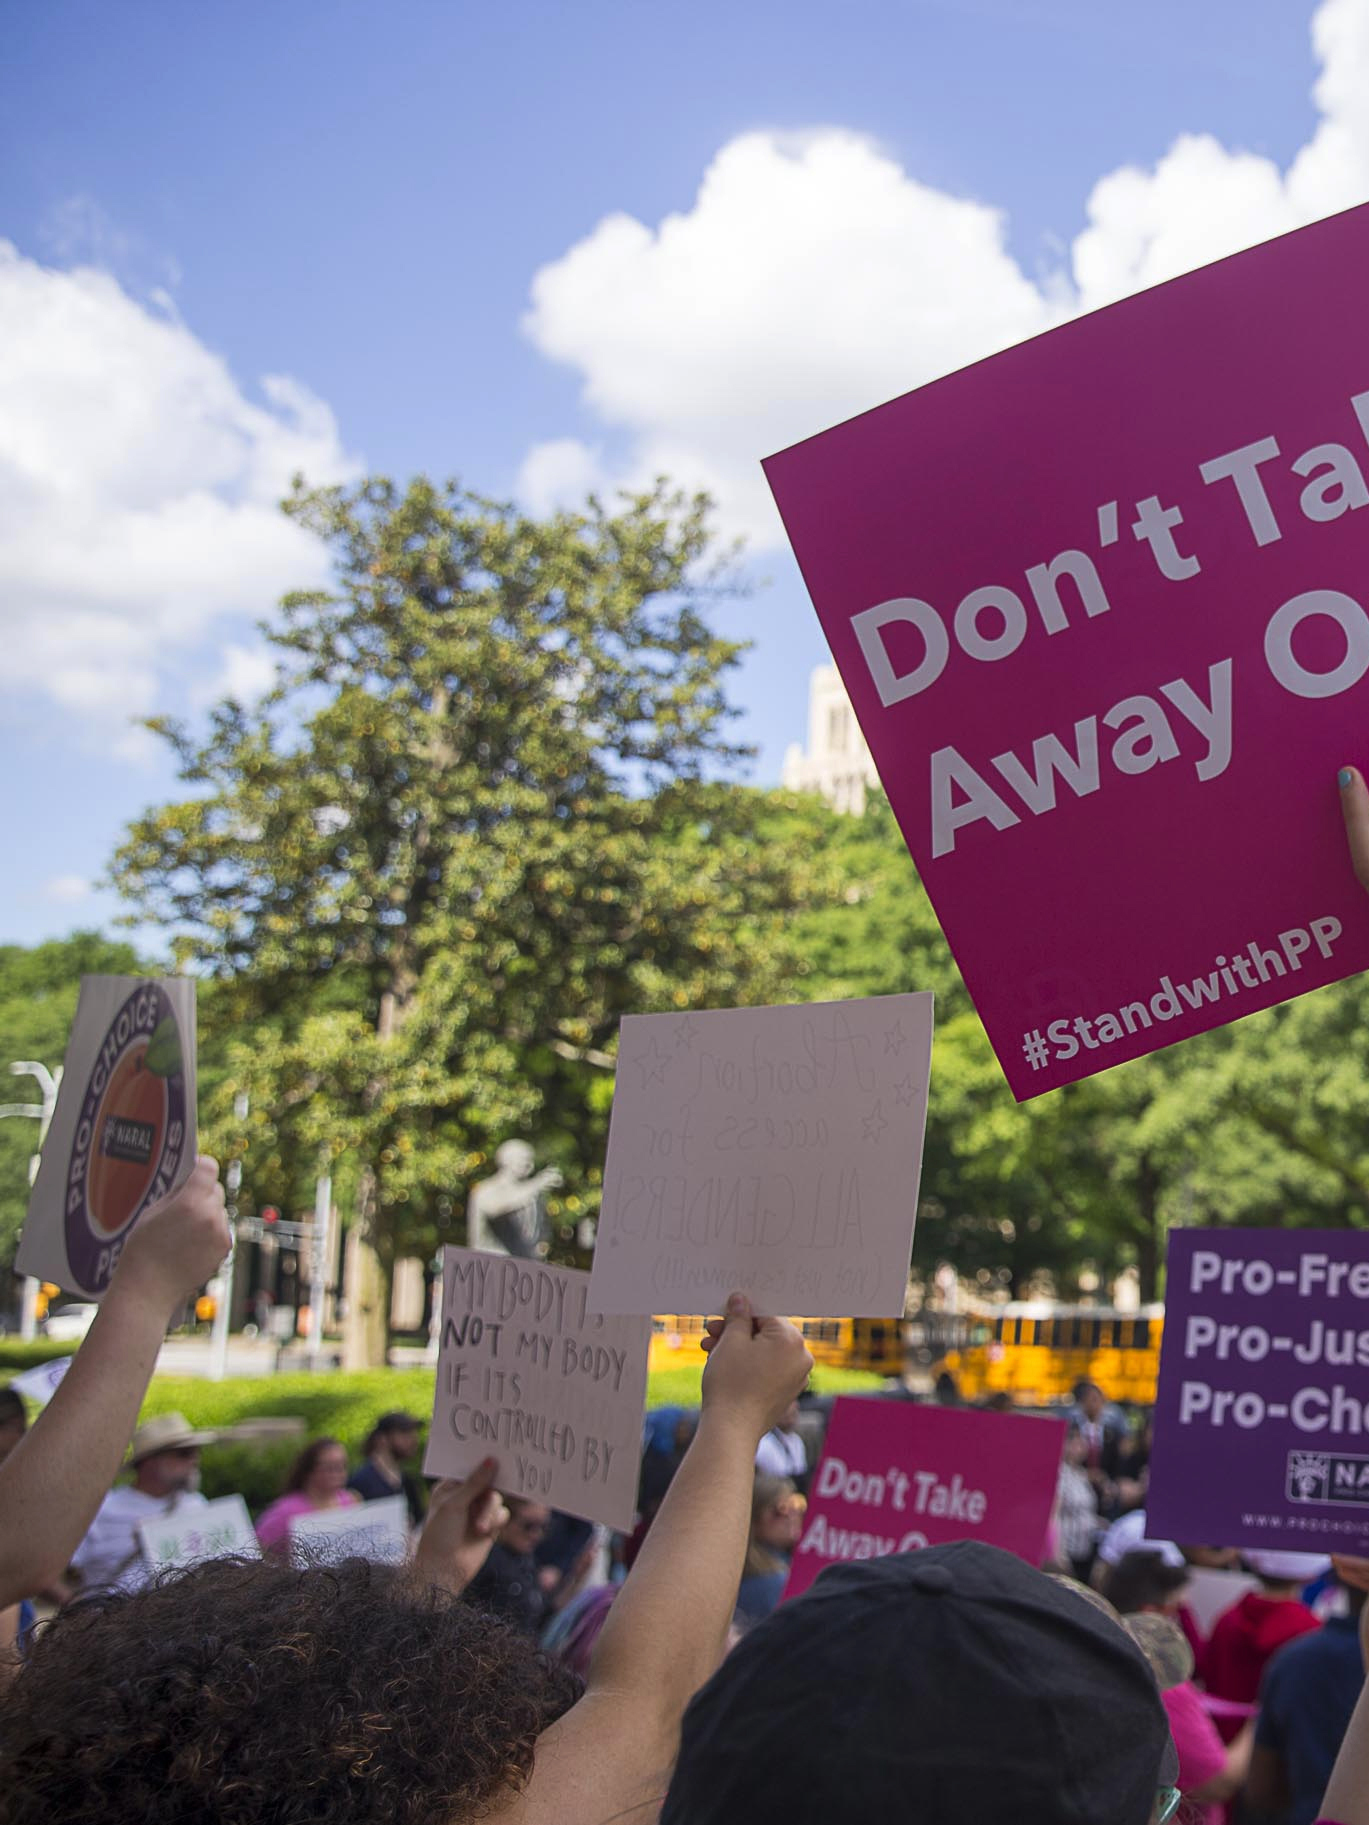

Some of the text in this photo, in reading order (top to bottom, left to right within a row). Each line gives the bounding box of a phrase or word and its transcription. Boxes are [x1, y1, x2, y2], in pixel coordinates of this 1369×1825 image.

[850, 495, 1202, 708] Don't
[931, 658, 1233, 859] Away
[1022, 916, 1343, 1071] #StandwithPP
[68, 993, 158, 1215] PRO-CHOICE
[115, 1125, 152, 1150] NARAL
[449, 1259, 490, 1311] MY
[500, 1260, 568, 1333] BODY
[443, 1315, 628, 1392] NOT MY BODY
[449, 1362, 521, 1404] IF ITS
[451, 1404, 614, 1484] CONTROLLED BY
[515, 1455, 552, 1494] YOU
[817, 1457, 987, 1524] Don't Take
